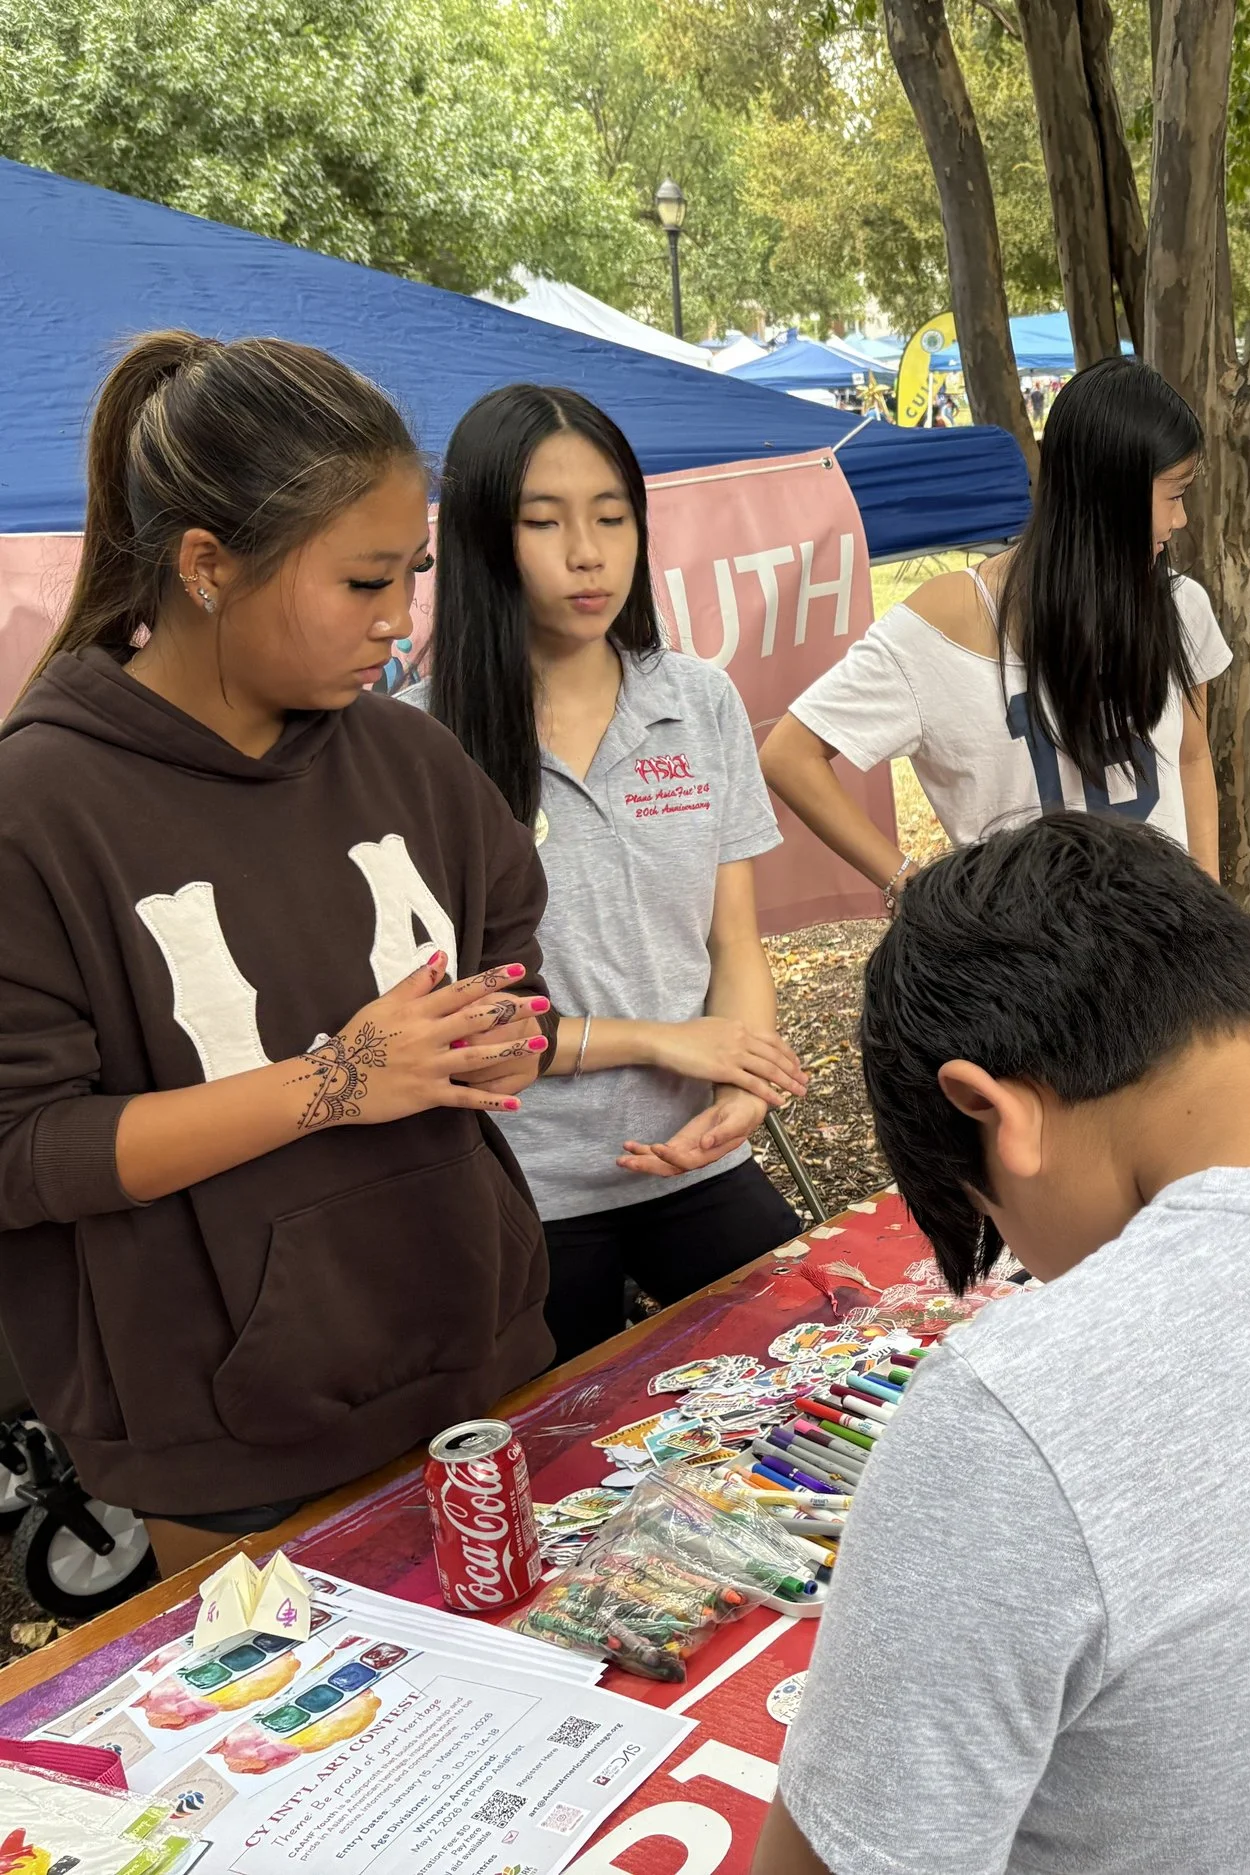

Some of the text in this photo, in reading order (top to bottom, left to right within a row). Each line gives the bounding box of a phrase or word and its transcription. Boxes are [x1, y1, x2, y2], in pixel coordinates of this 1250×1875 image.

[635, 801, 710, 818] 20th Anniversary
[686, 1452, 736, 1466] AILAND
[509, 1490, 524, 1558] ORIGINAL TASTE
[245, 1824, 271, 1848] CY
[316, 1752, 351, 1782] ART
[349, 1691, 420, 1752] CONTEST
[270, 1699, 442, 1847] Theme: Be proud of your heritage
[335, 1835, 363, 1859] Entry
[359, 1809, 390, 1834] Dates:
[389, 1778, 423, 1808] January
[435, 1741, 464, 1763] March
[470, 1713, 493, 1731] 2026
[516, 1748, 559, 1788] Register Here
[410, 1835, 433, 1853] May
[438, 1807, 463, 1828] 2026
[468, 1775, 493, 1797] Plano
[491, 1745, 526, 1775] AsiaFest
[413, 1754, 499, 1833] Winners Announced:
[313, 1811, 339, 1830] Youth
[370, 1833, 390, 1851] Age
[386, 1795, 431, 1833] Divisions:
[450, 1827, 482, 1856] Pay here
[456, 1824, 471, 1837] $10
[450, 1831, 492, 1872] aid available
